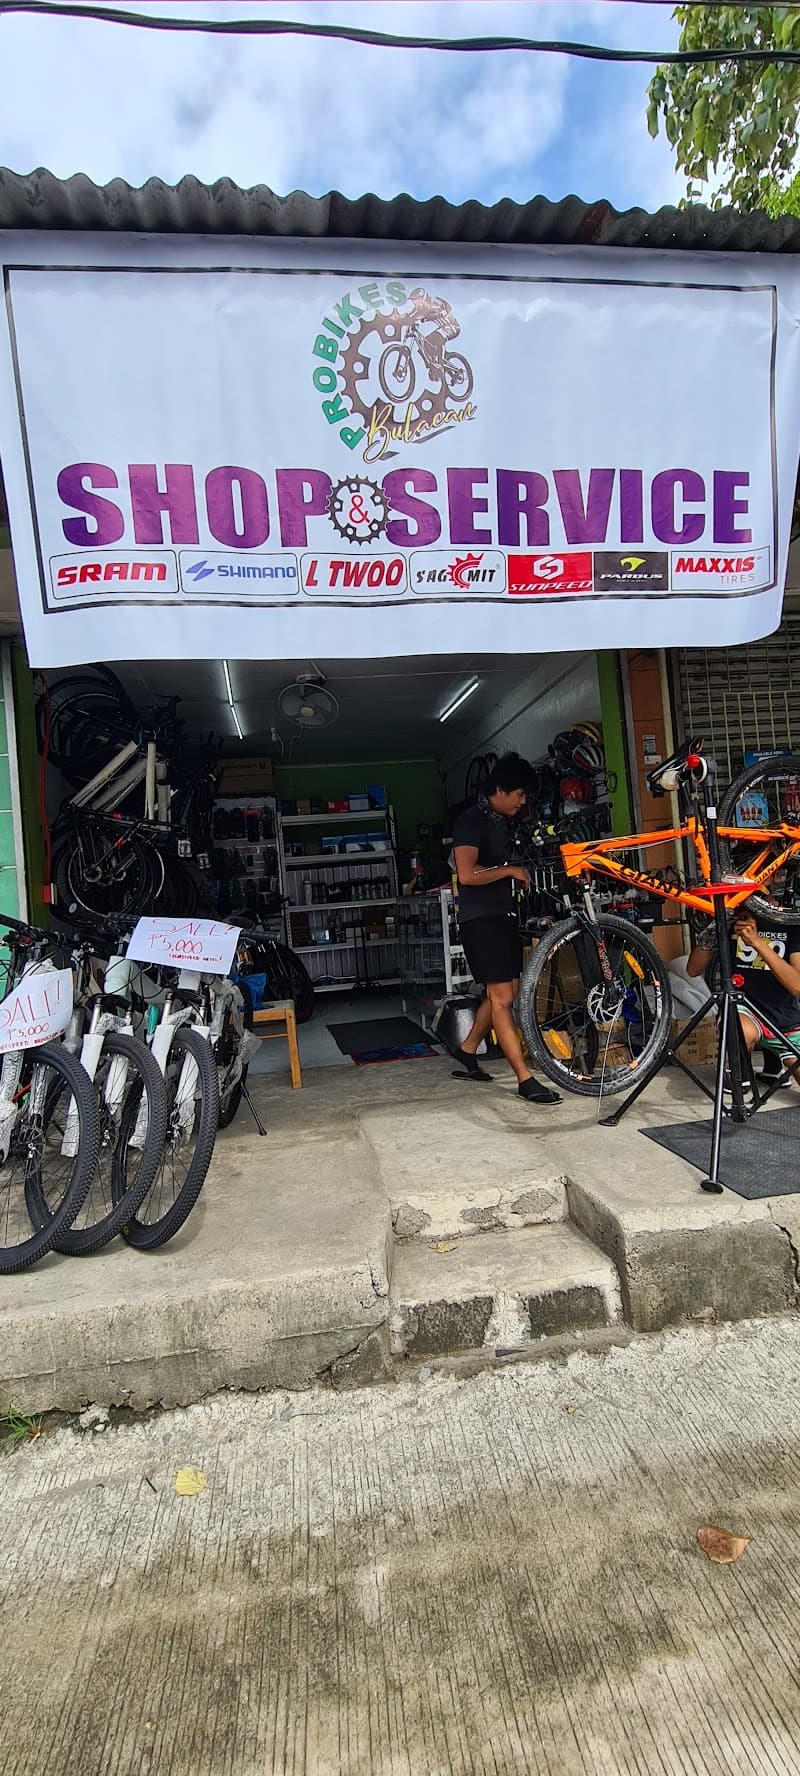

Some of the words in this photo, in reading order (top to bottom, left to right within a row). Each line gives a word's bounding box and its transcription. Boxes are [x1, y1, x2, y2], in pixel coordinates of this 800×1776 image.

[312, 281, 407, 450] PROBIKES
[363, 402, 477, 464] Bulacan
[57, 462, 333, 549] SHOP
[349, 494, 371, 524] &
[381, 467, 753, 548] SERVICE
[57, 562, 167, 587] SRAM
[217, 564, 297, 580] SHIMANO
[329, 558, 405, 588] TWOO
[674, 556, 756, 573] MAXXIS
[509, 580, 593, 591] SUNPEED
[720, 573, 756, 585] TIRES
[620, 865, 684, 897] GIANT
